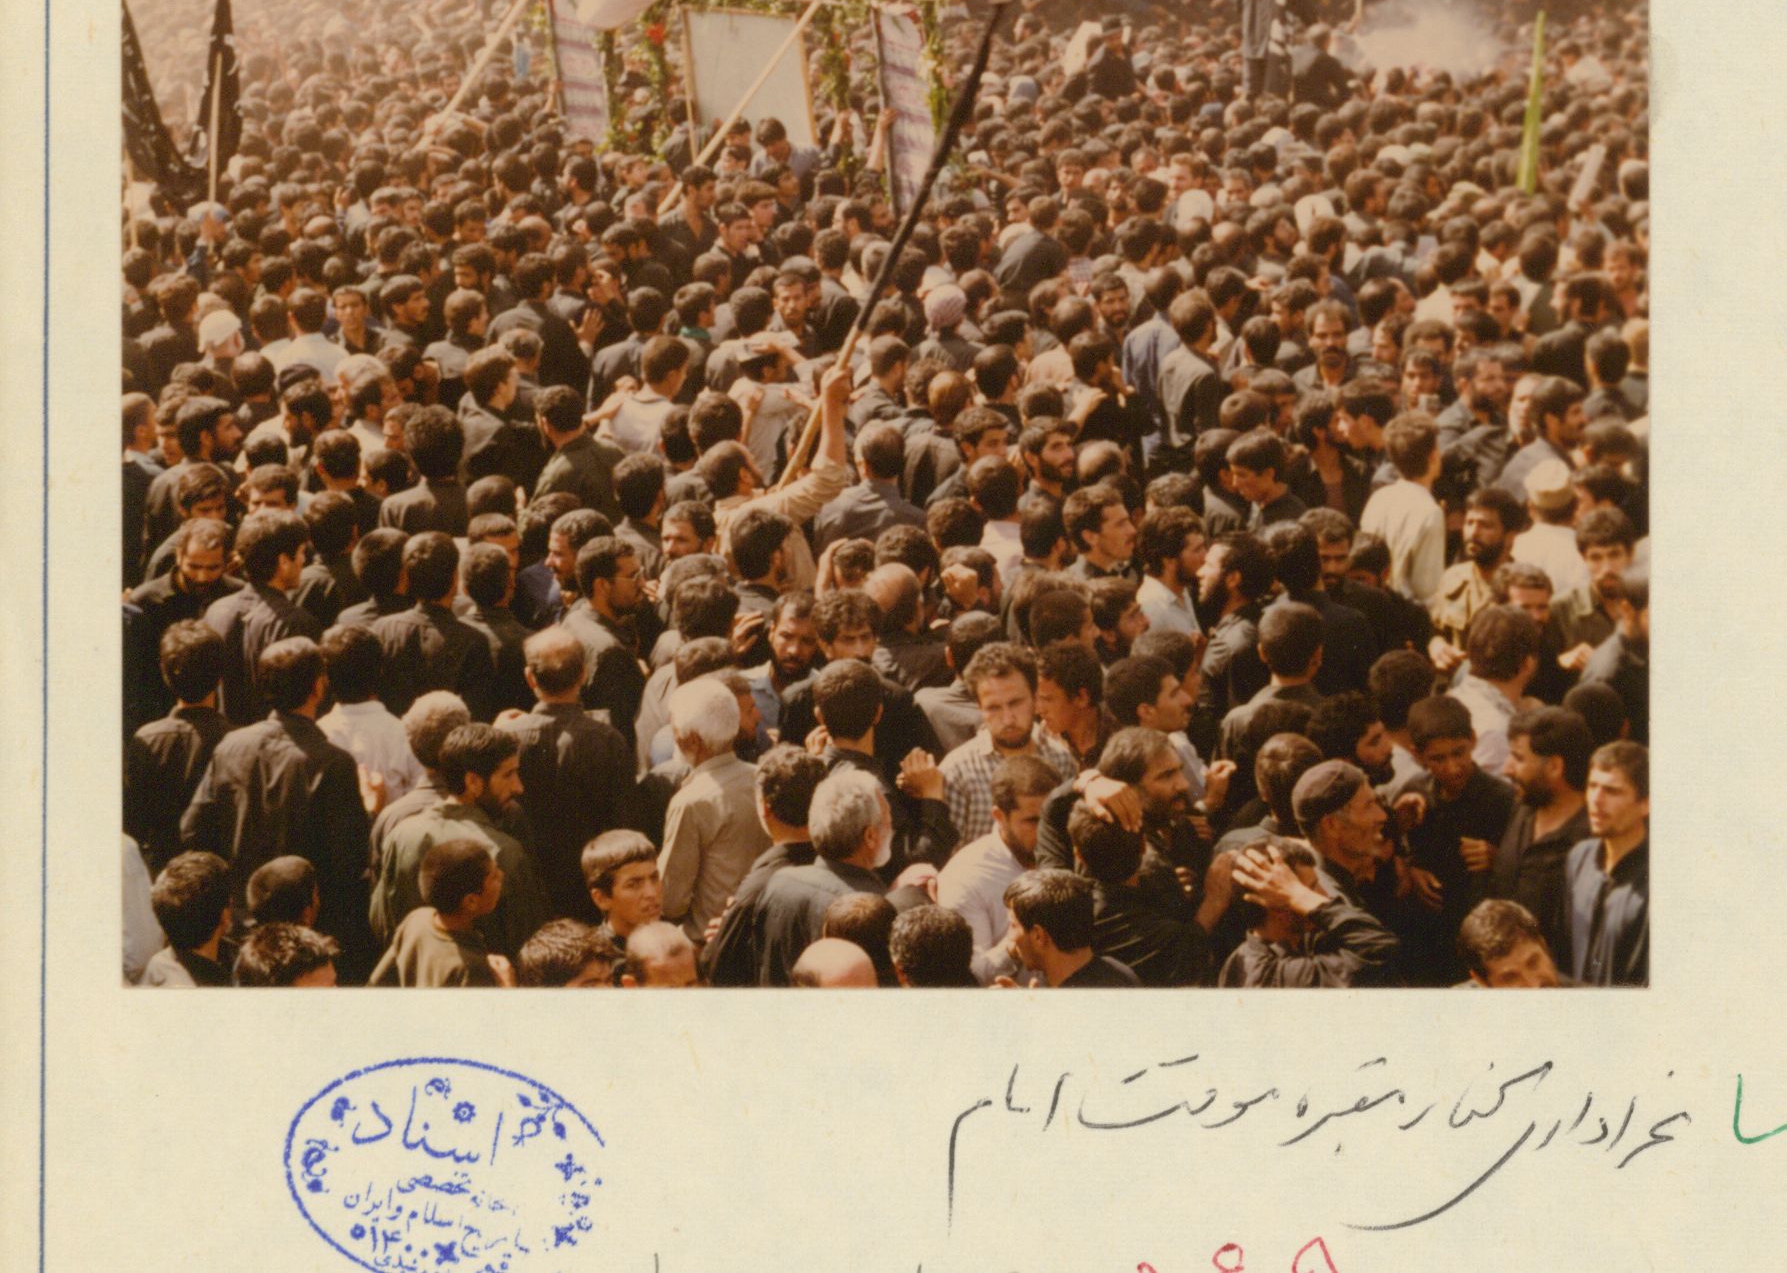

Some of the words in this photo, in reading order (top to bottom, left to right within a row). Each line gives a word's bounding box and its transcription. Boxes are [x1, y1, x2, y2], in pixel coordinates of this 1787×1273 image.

[351, 1085, 503, 1166] اسناد
[1077, 1053, 1280, 1129] موقت
[1276, 1057, 1406, 1154] مقبره
[1397, 1060, 1553, 1131] کنار
[946, 1063, 1071, 1233] امام
[1341, 1069, 1692, 1231] عزاداری
